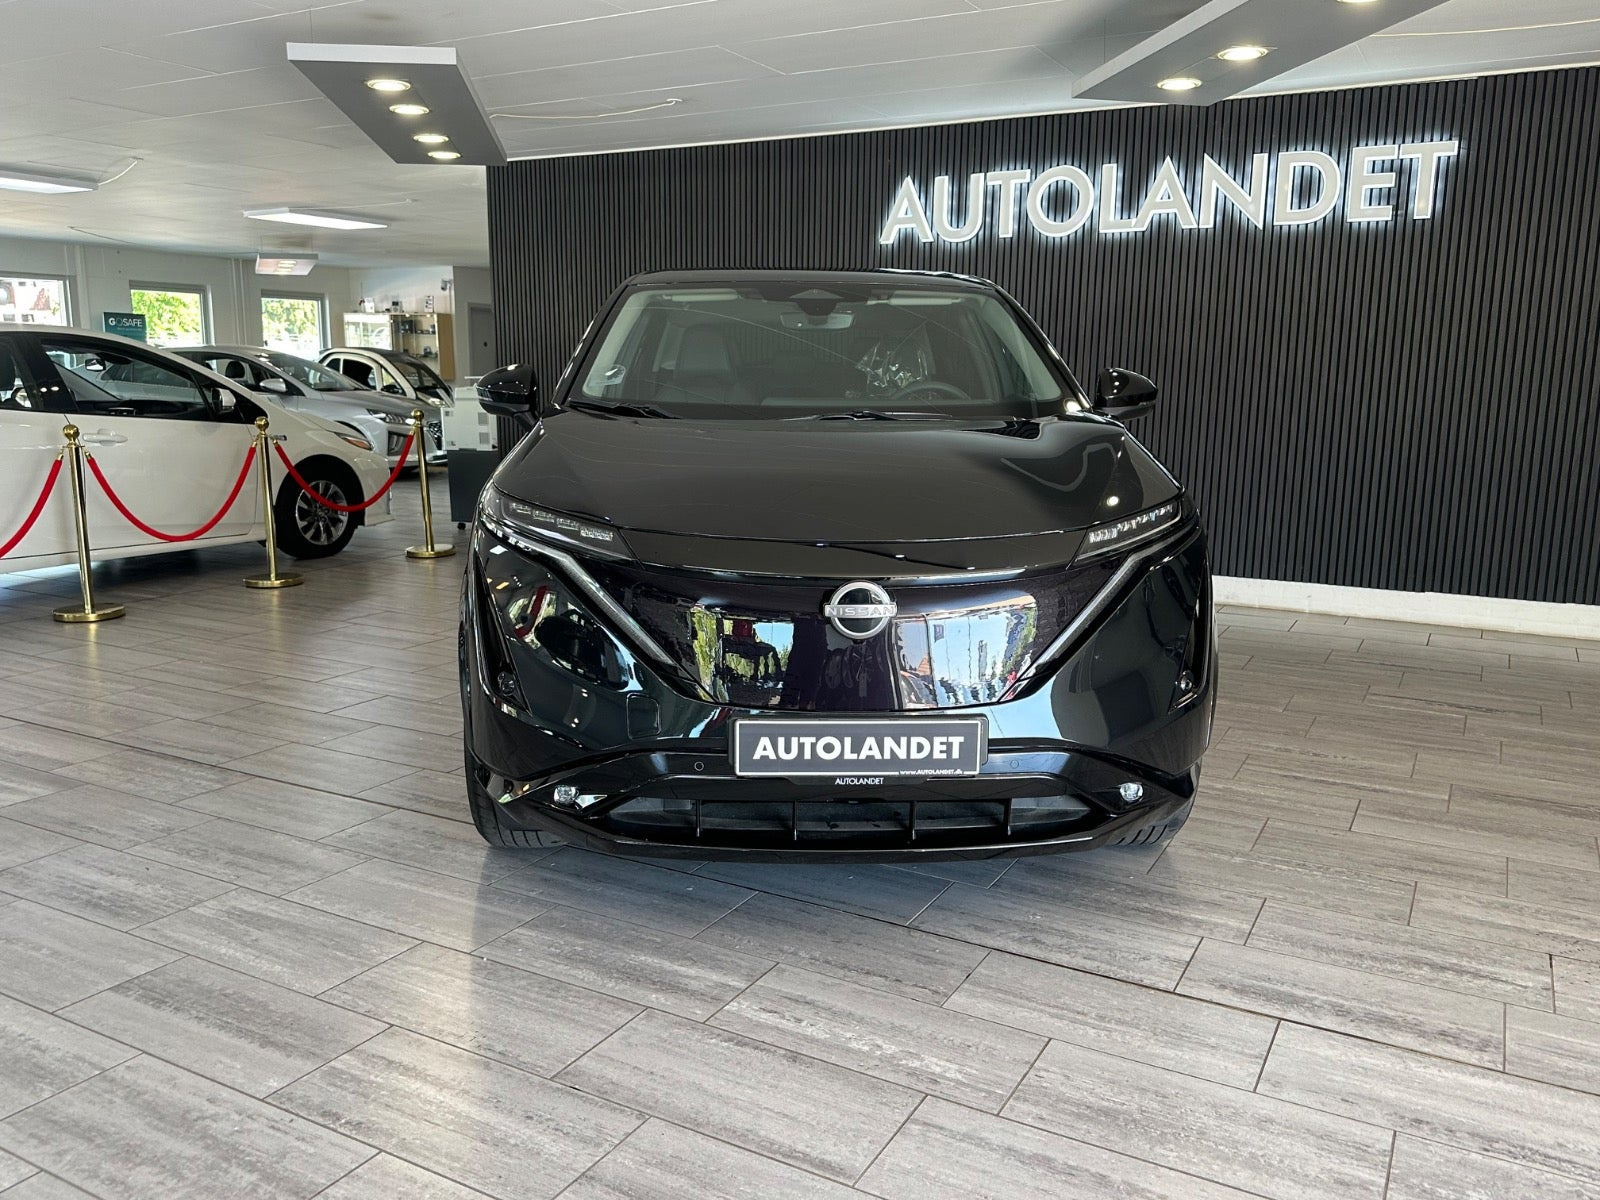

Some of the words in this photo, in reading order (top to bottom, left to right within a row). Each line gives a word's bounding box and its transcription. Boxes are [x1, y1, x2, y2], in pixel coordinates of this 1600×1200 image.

[879, 139, 1459, 245] AUTOLANDET
[826, 606, 895, 617] NISSAN
[752, 735, 965, 760] AUTOLANDET
[834, 777, 885, 786] AUTOLANDET
